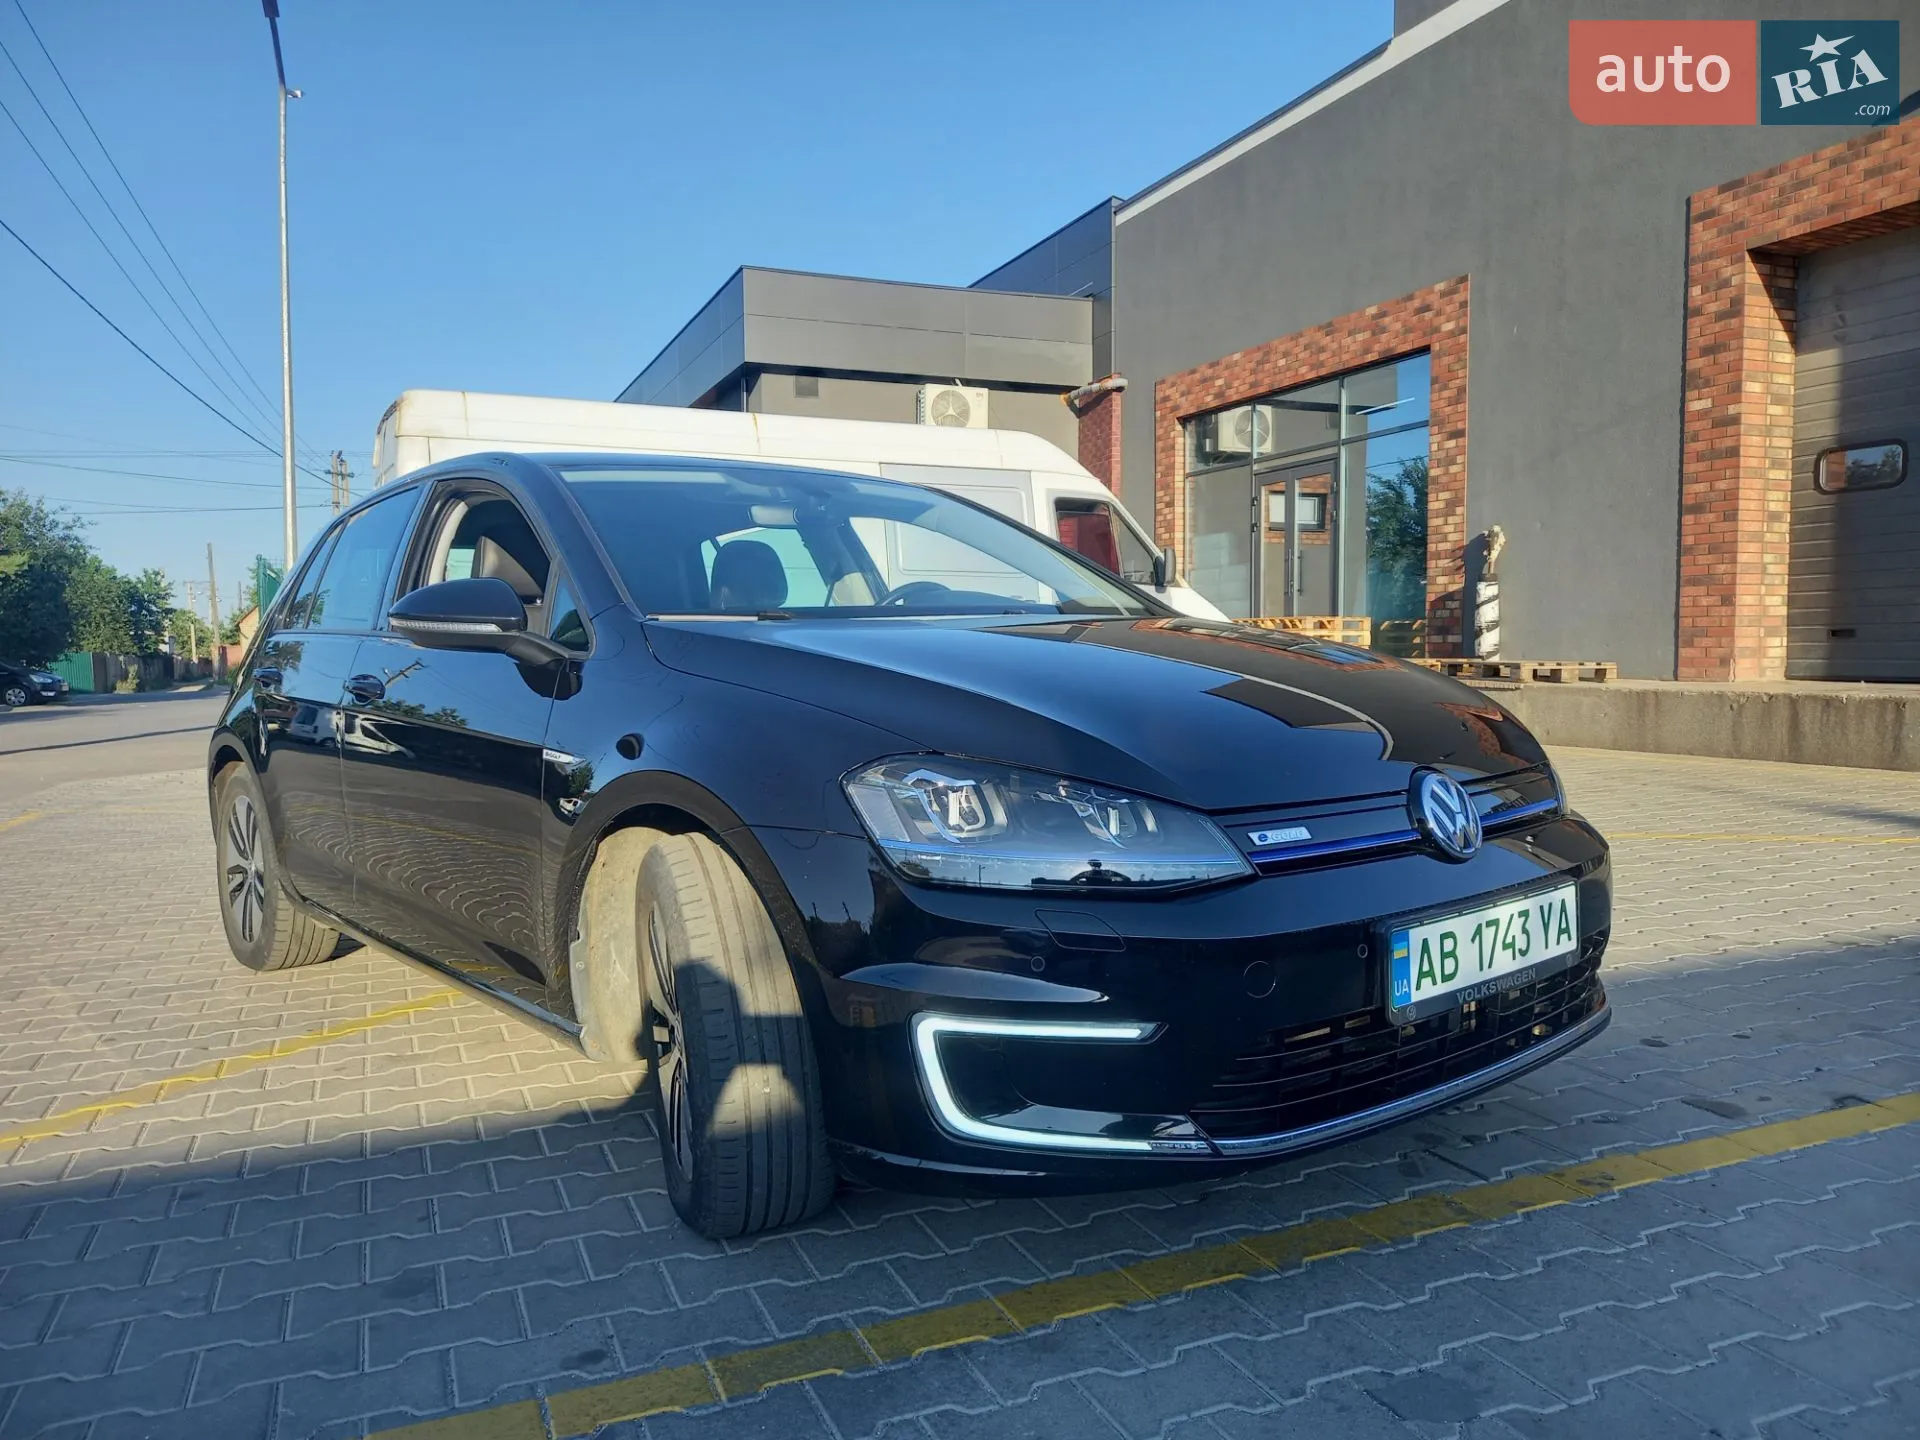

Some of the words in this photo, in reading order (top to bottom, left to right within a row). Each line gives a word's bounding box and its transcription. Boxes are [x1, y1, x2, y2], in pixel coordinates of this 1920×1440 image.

[1415, 930, 1459, 992] AB
[1470, 907, 1531, 973] 1743
[1539, 898, 1573, 950] YA
[1394, 977, 1410, 997] UA
[1455, 967, 1537, 1005] VOLKSWAGEN
